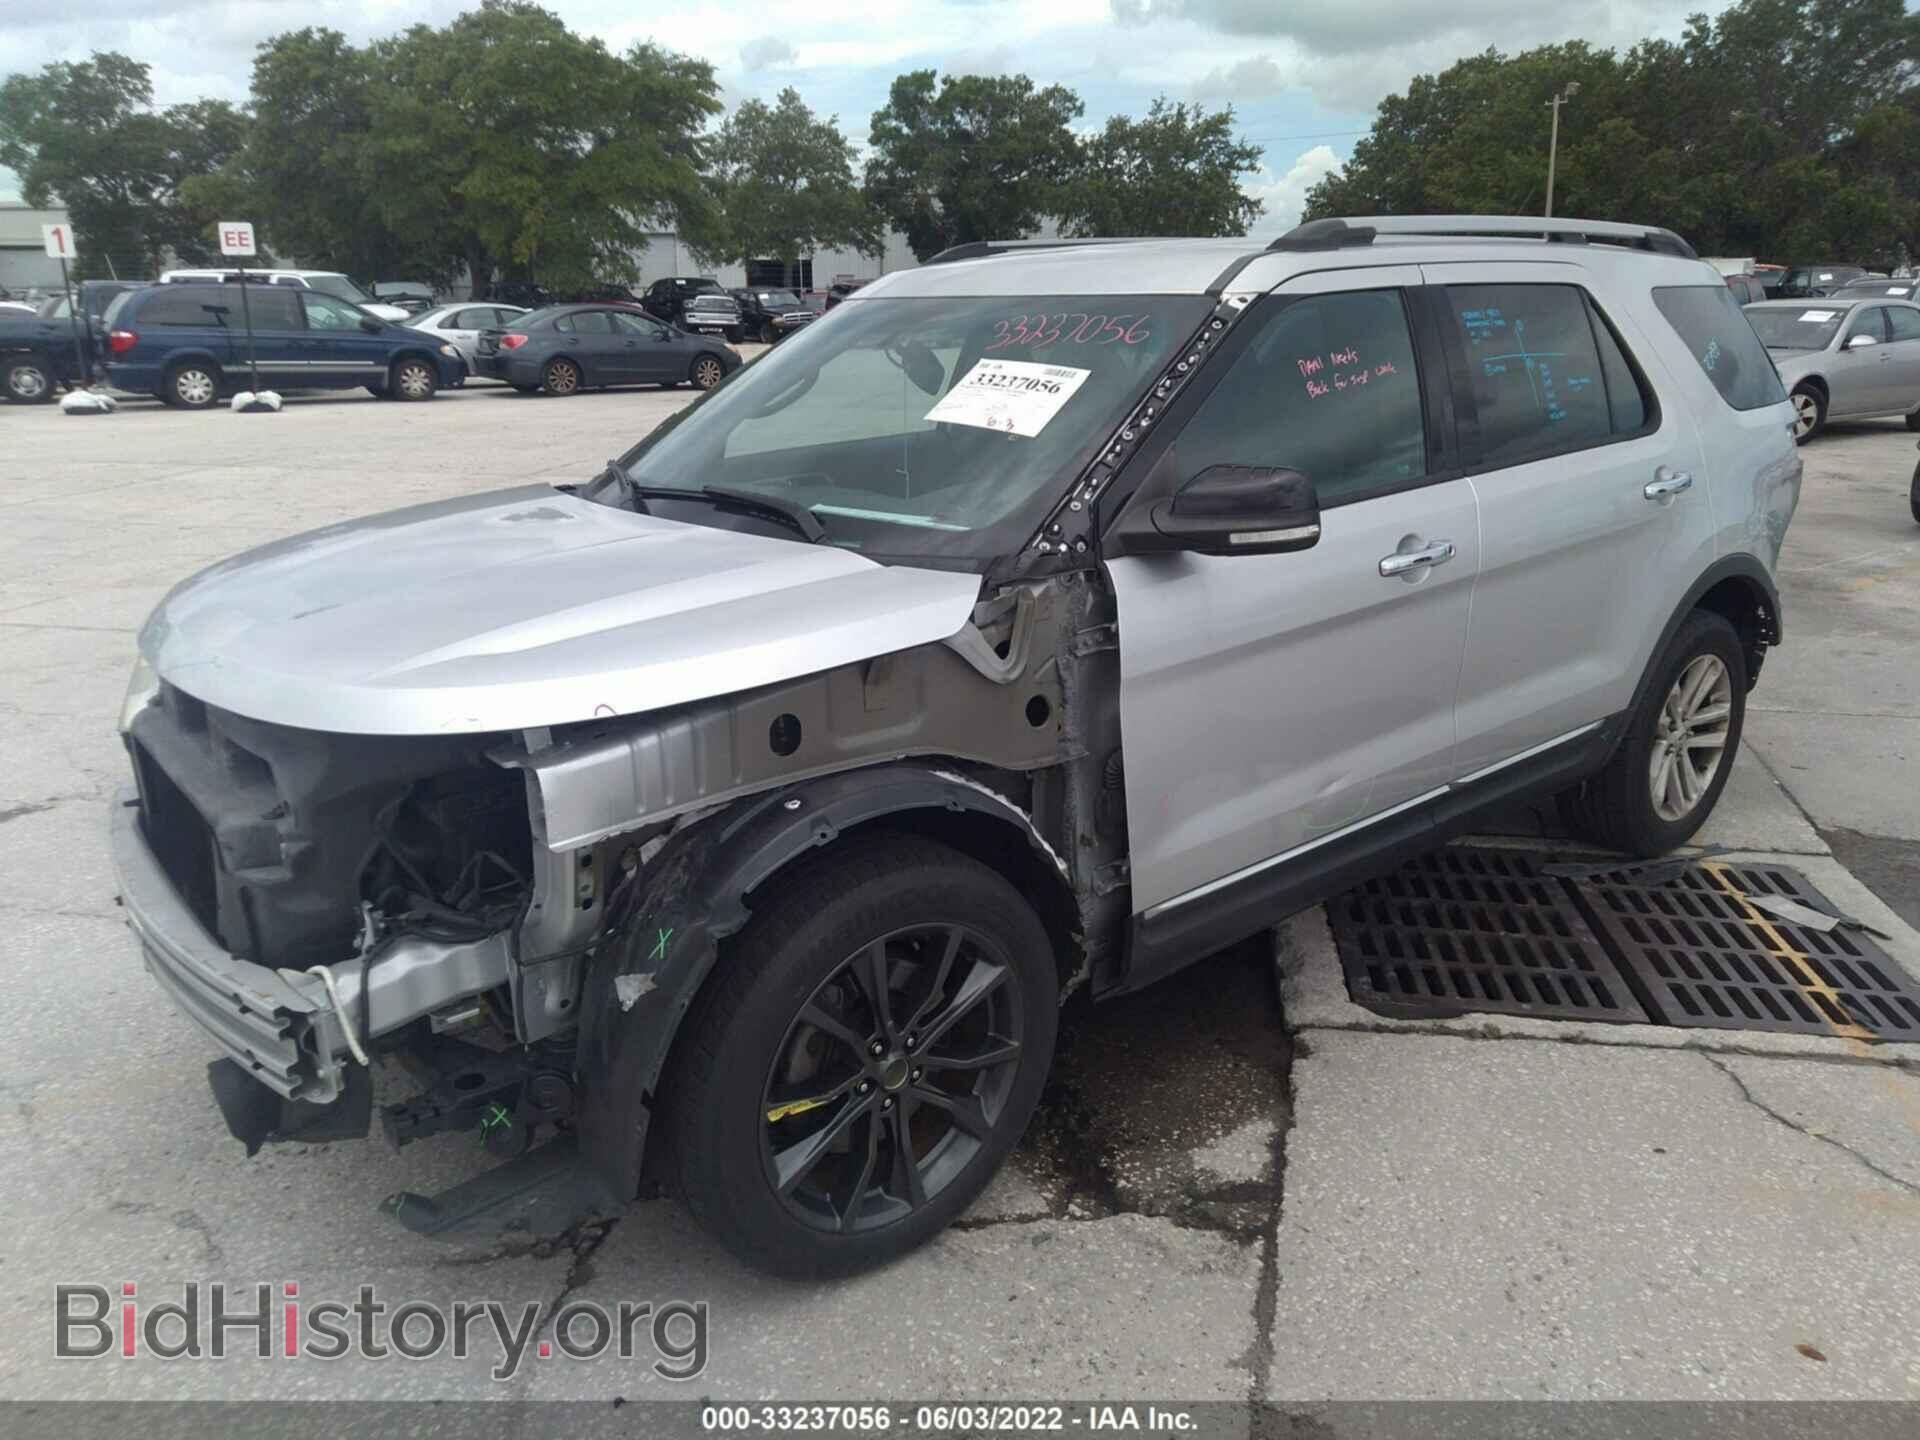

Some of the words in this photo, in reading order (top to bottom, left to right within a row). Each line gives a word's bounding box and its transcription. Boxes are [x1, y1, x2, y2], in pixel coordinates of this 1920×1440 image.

[51, 227, 65, 254] 1
[224, 231, 250, 247] EE
[985, 313, 1150, 350] 33237056
[970, 373, 1062, 394] 33237056
